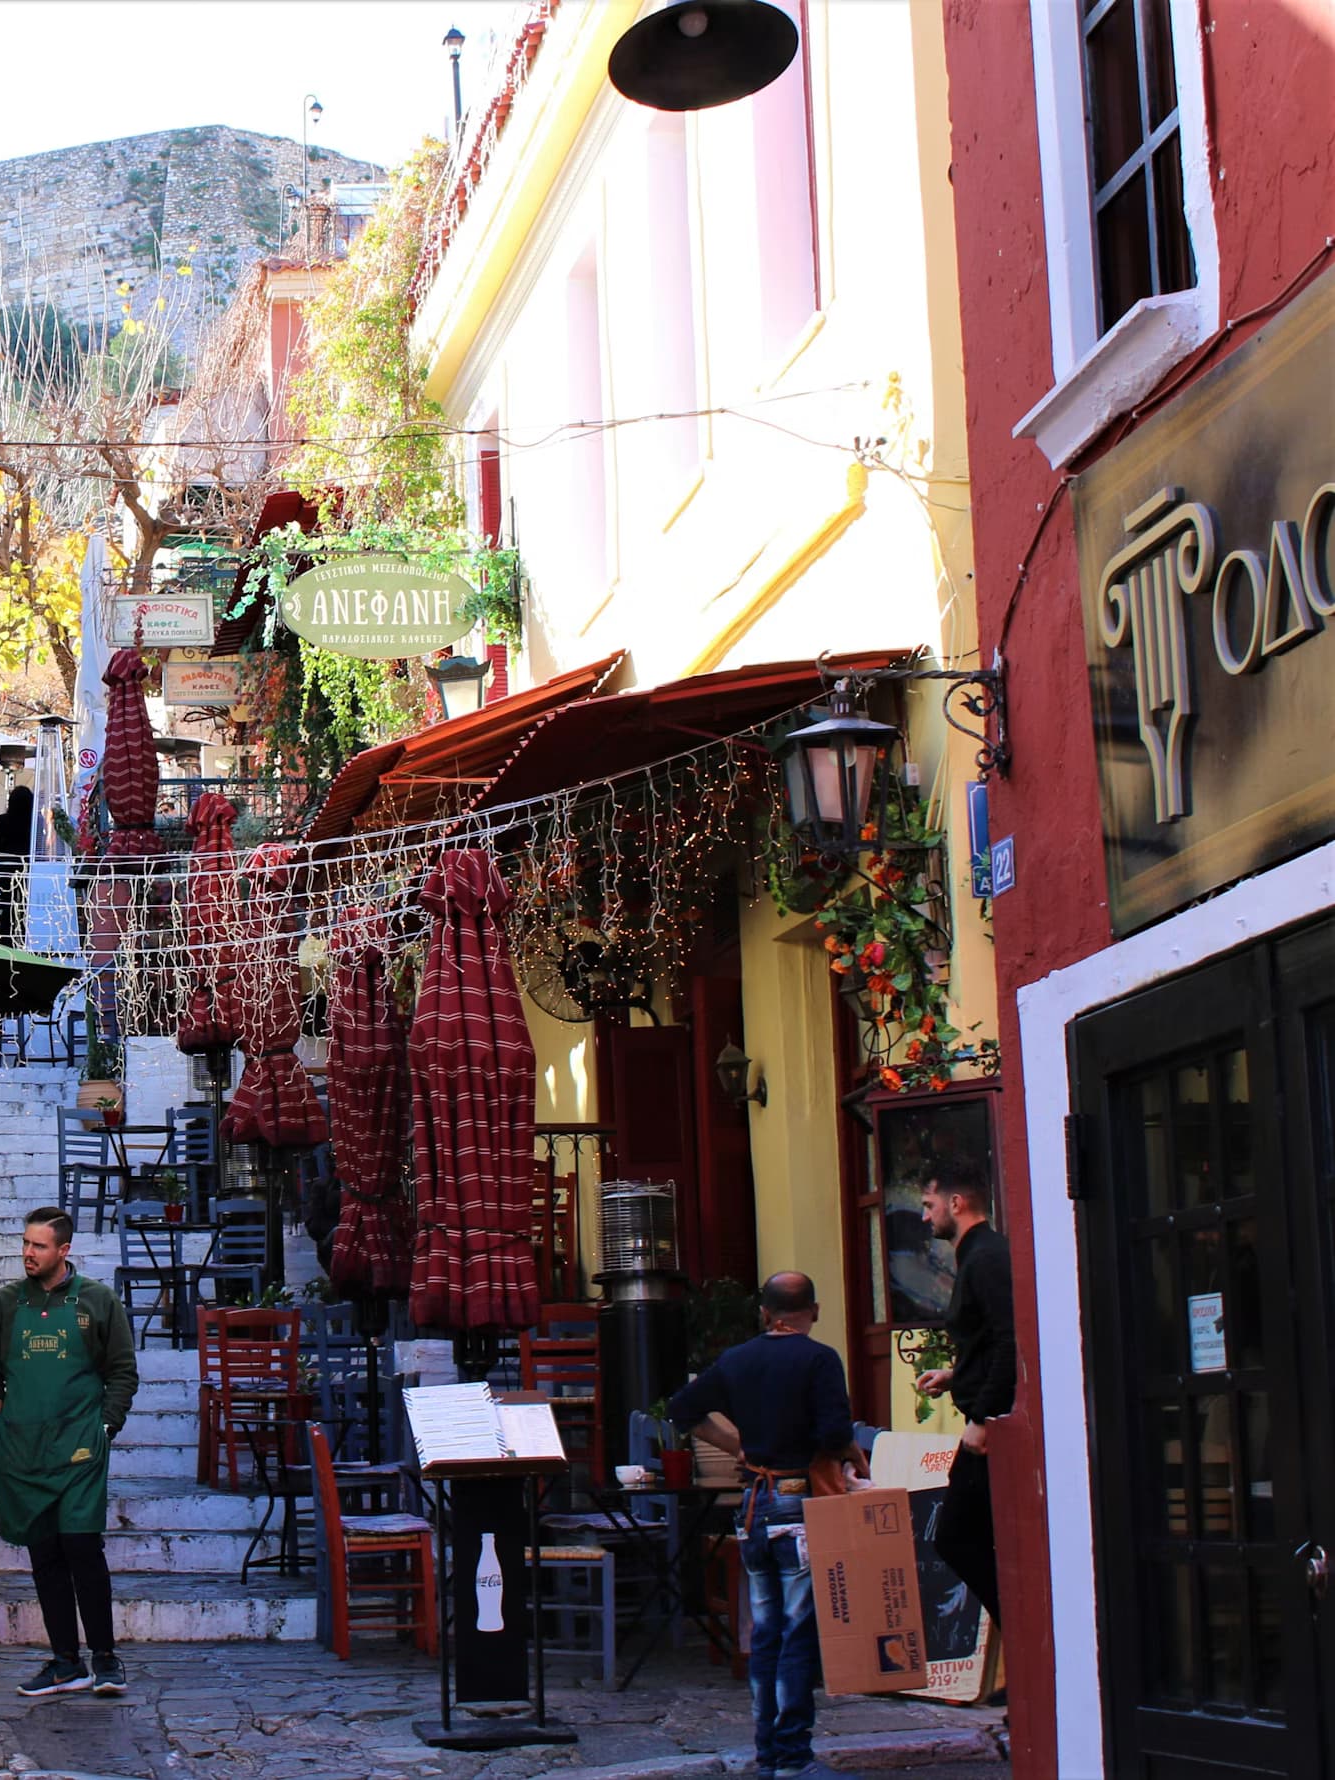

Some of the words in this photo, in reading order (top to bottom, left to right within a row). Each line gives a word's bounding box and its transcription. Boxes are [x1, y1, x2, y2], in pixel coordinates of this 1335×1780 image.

[314, 563, 366, 582] ΓΕΥΣΤΙΚΟΝ
[310, 589, 452, 625] ΑΝΕΦΑΝΗ
[321, 633, 396, 644] ΠΑΡΑΔΟΣΙΑΚΟΣ
[401, 633, 445, 644] ΚΑΦΕΝΕΣ
[996, 848, 1011, 884] 22
[828, 1568, 840, 1619] ΠΡΟΣΟΧΗ
[836, 1562, 850, 1624] ΕΥΘΡΑΥΣΤΟ
